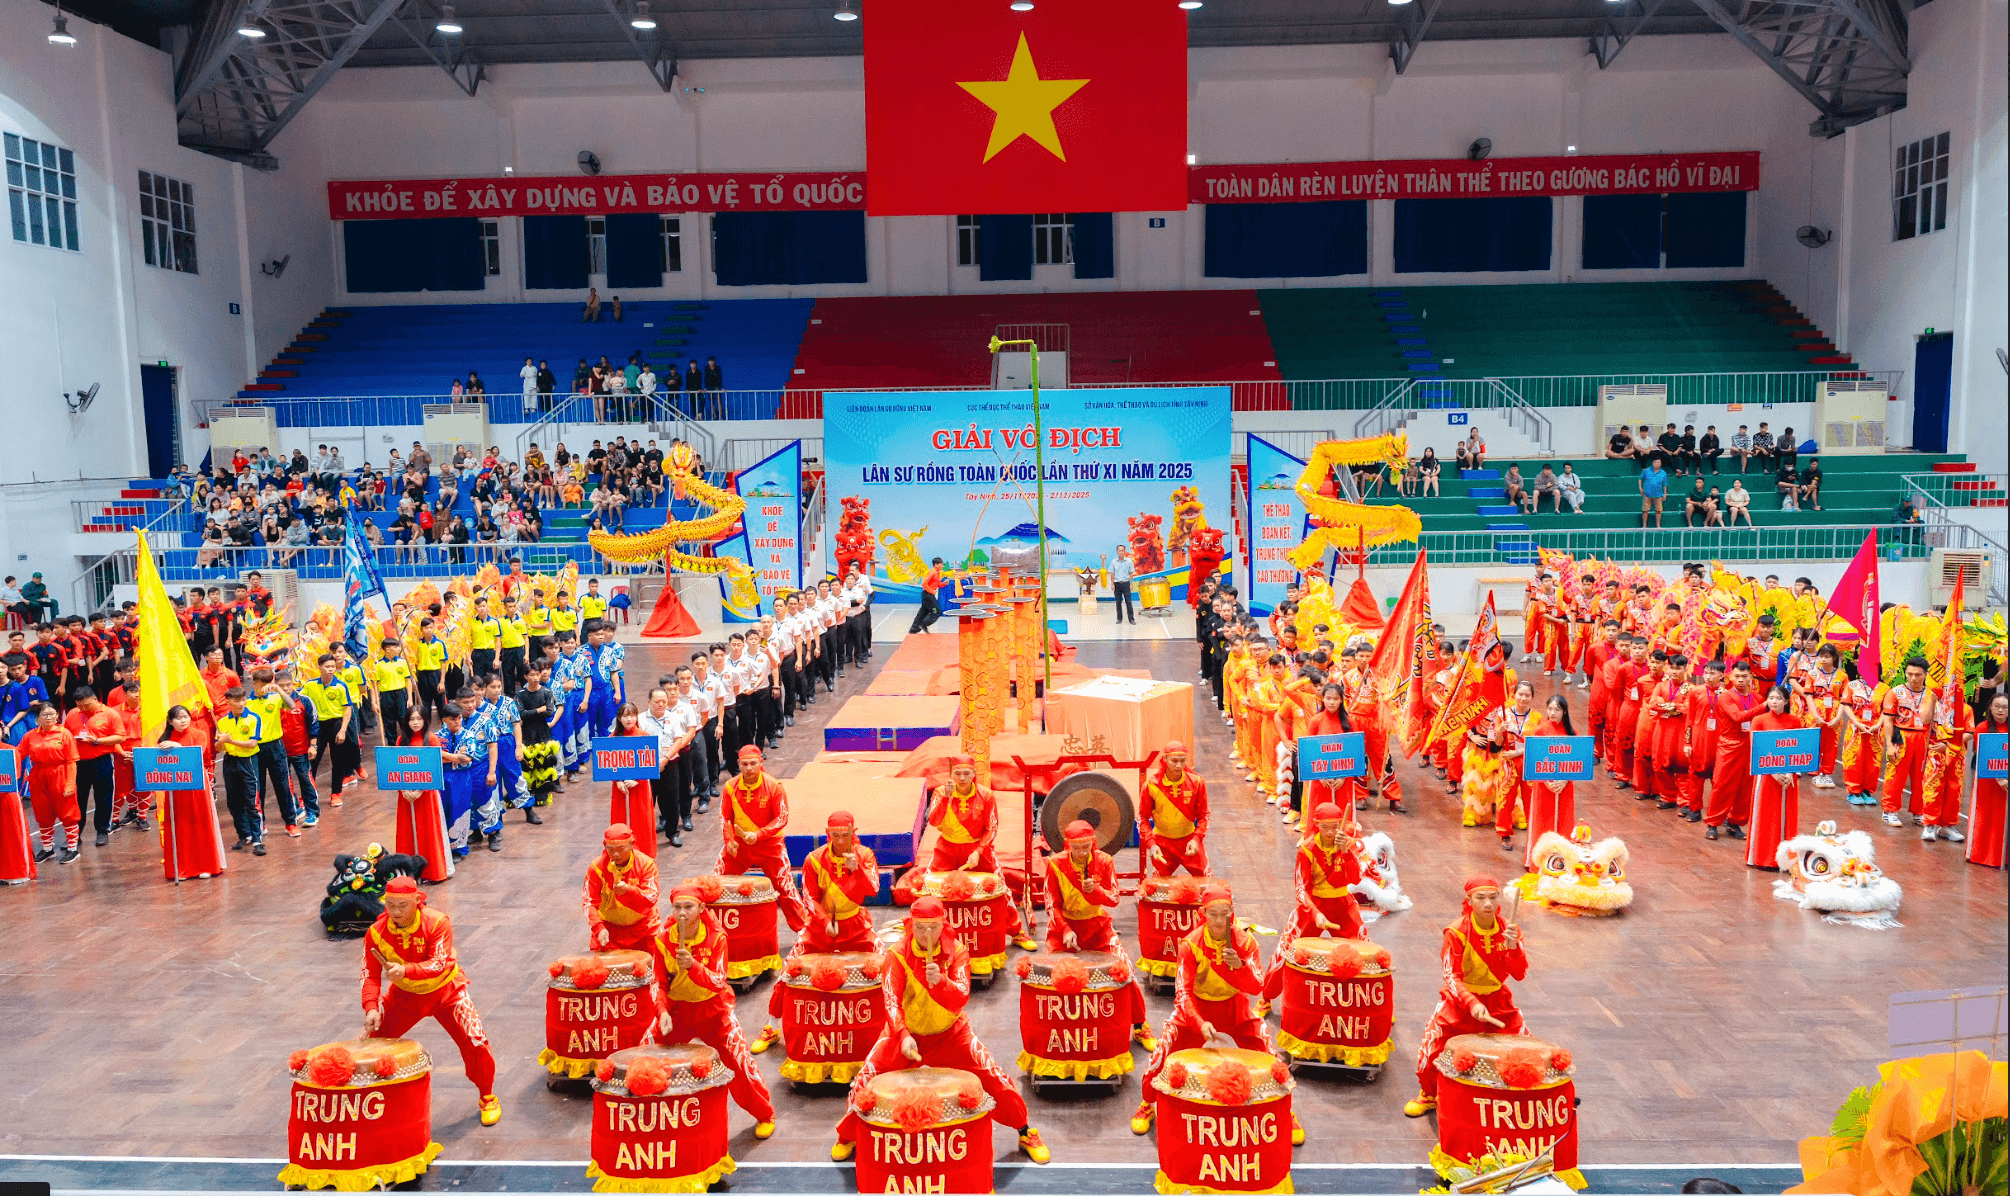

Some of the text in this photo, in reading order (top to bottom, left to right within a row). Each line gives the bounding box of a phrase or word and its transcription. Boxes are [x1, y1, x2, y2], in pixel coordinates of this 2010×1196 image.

[1205, 159, 1740, 198] TOÀN DÂN RÈN LUYỆN THÂN THỂ THEO GƯƠNG BÁC HỒ VĨ ĐẠI
[345, 174, 863, 212] KHỎE ĐỂ XÂY DỰNG VÀ BẢO VỆ TỔ QUỐC
[1451, 415, 1464, 424] B4
[932, 423, 1121, 454] GIẢI VÔ ĐỊCH
[863, 459, 1193, 482] LÂN SƯ RỒNG TOÀN QUỐC LẦN THỨ XI NĂM 2025
[1275, 504, 1291, 517] THAO
[772, 538, 794, 550] DỰNG
[1256, 548, 1276, 561] TRUNG
[1257, 570, 1269, 583] CAO
[1321, 742, 1343, 754] ĐOÀN
[1548, 744, 1572, 754] ĐOÀN
[1776, 737, 1798, 748] ĐOÀN
[157, 753, 179, 764] ĐOÀN
[398, 753, 419, 764] ĐOÀN
[596, 745, 656, 772] TRỌNG TÀI
[1311, 757, 1354, 773] TÂY NINH
[1535, 756, 1583, 773] BẮC NINH
[1788, 752, 1813, 766] THÁP
[175, 771, 192, 783] NAI
[388, 771, 433, 783] AN GIANG
[943, 905, 992, 929] UNG
[1152, 909, 1202, 931] TRUN
[558, 992, 638, 1021] TRUNG
[1035, 993, 1115, 1020] TRUNG
[1305, 980, 1385, 1007] TRUNG
[793, 998, 872, 1026] TRUNG
[567, 1025, 619, 1053] ANH
[1047, 1027, 1098, 1053] ANH
[1317, 1014, 1370, 1040] ANH
[803, 1030, 854, 1056] ANH
[295, 1090, 386, 1123] TRUNG
[606, 1097, 701, 1132] TRUNG
[1473, 1095, 1569, 1130] TRUNG
[1181, 1112, 1278, 1147] TRUNG
[299, 1132, 357, 1161] ANH
[615, 1140, 676, 1171] ANH
[870, 1129, 968, 1165] TRUNG
[1497, 1134, 1556, 1160] ANH
[1199, 1152, 1261, 1182] ANH
[884, 1174, 946, 1194] ANH
